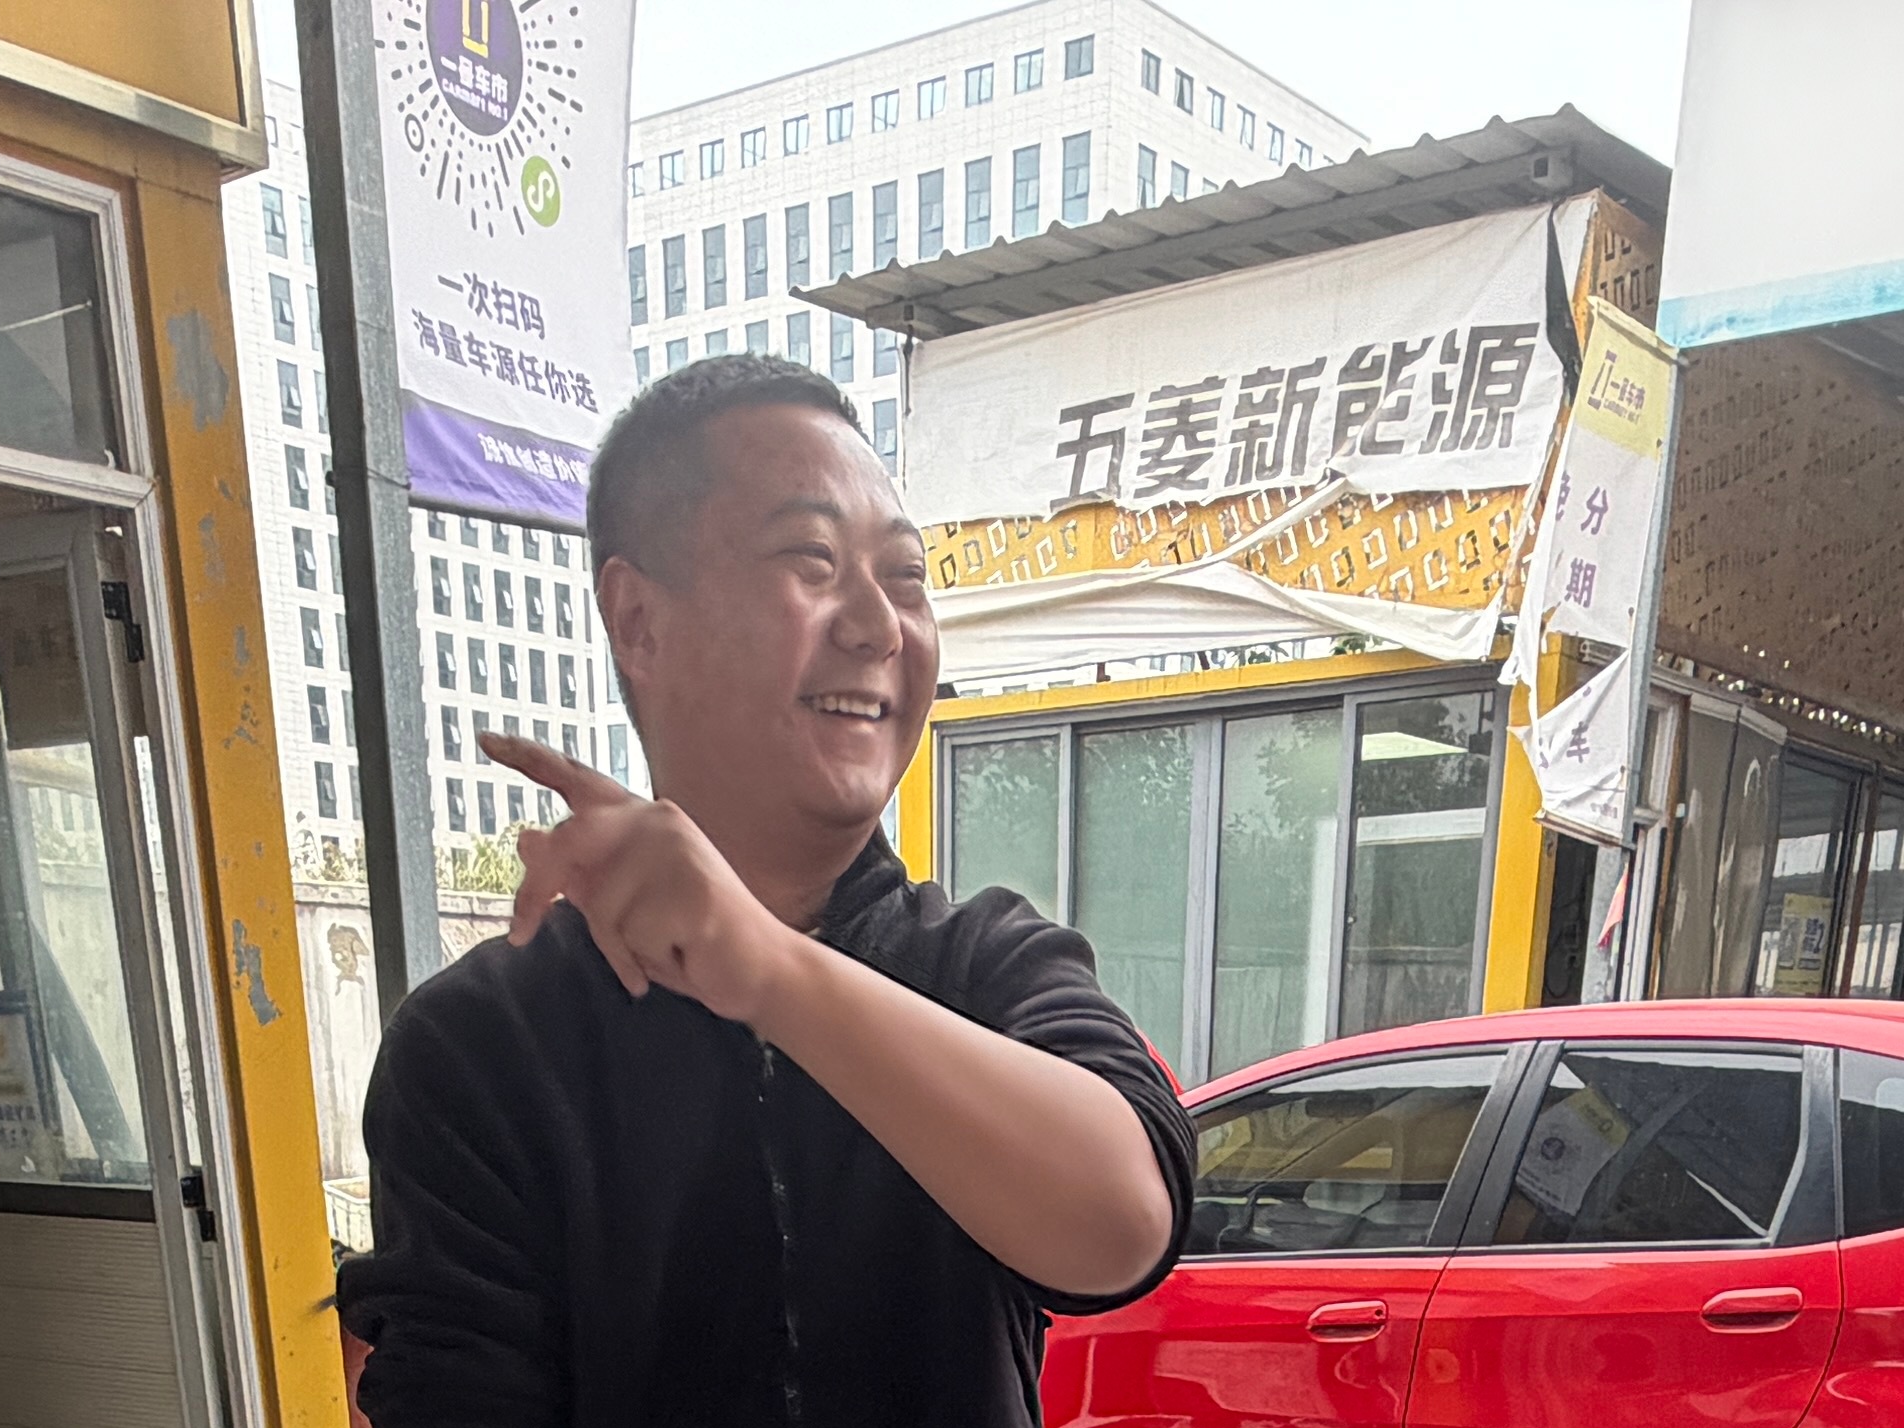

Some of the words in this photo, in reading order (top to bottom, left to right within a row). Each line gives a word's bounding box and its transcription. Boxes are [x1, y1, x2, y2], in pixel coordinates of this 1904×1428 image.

[440, 54, 508, 103] 一号车市
[437, 273, 545, 340] 一次扫码
[411, 307, 600, 414] 海量车源任你选
[1610, 376, 1646, 410] 一号车市
[1048, 321, 1541, 514] 五菱新能源
